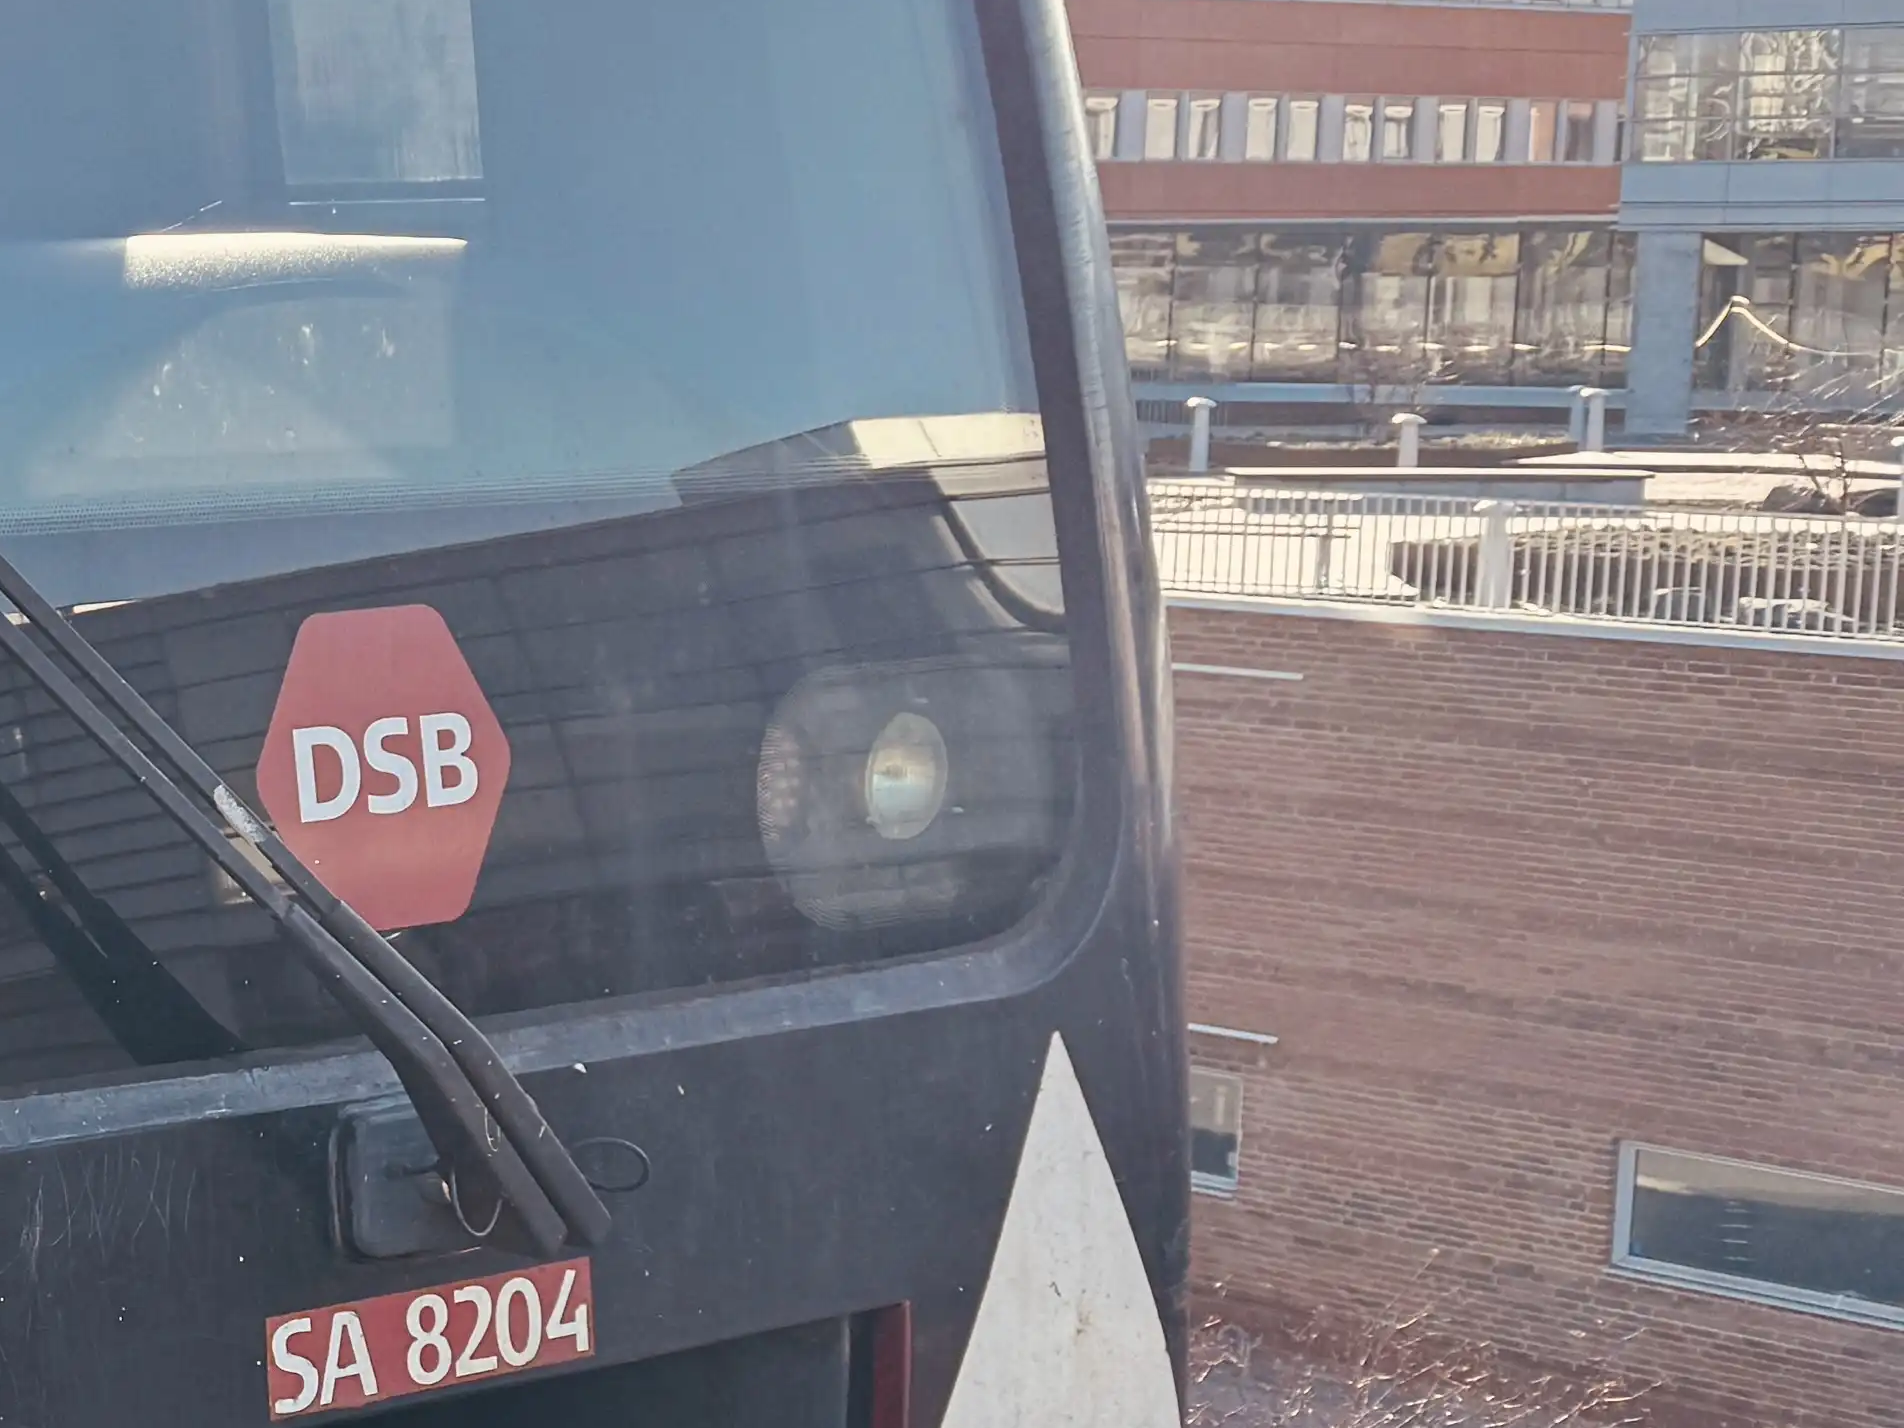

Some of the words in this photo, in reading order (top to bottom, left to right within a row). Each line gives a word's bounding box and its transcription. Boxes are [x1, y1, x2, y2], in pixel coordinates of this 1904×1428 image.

[292, 712, 479, 823] DSB
[271, 1310, 379, 1415] SA
[405, 1268, 591, 1386] 8204
